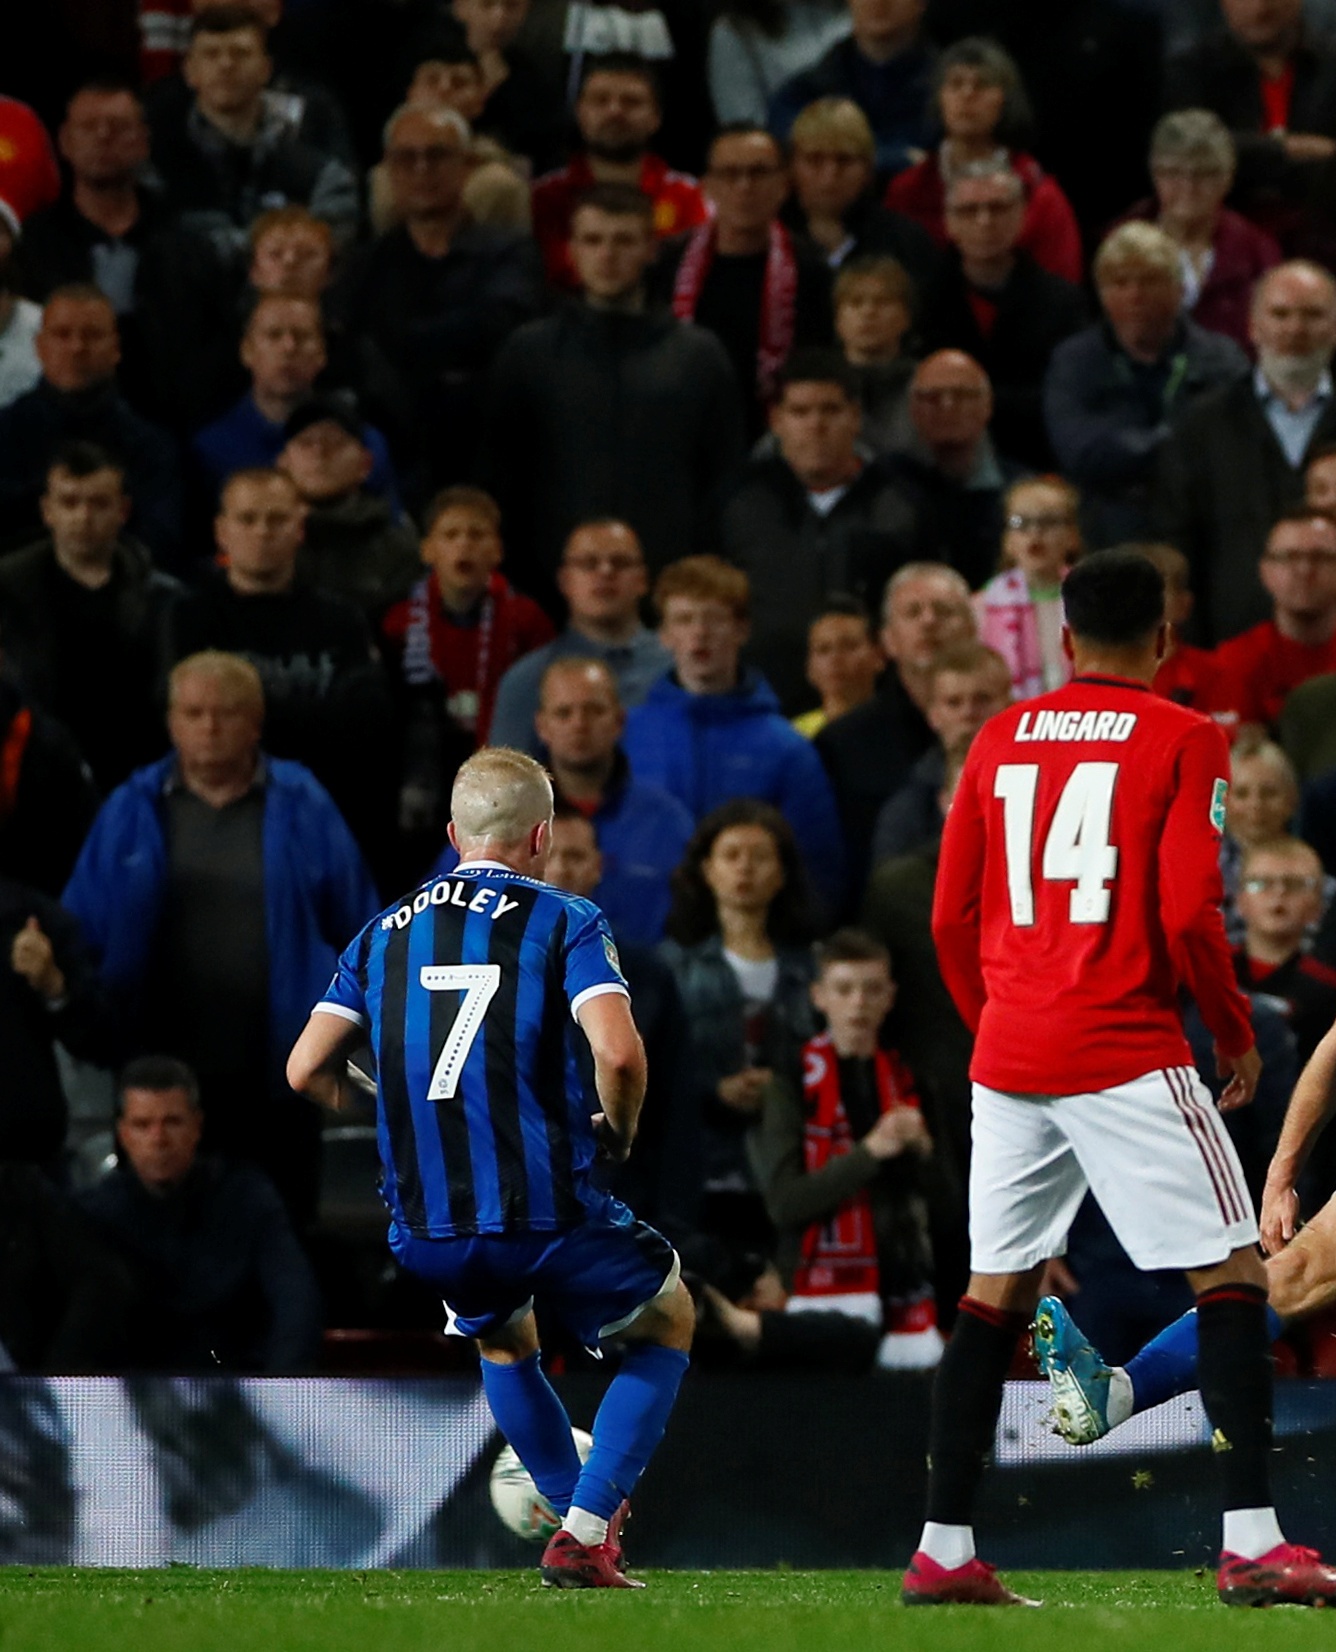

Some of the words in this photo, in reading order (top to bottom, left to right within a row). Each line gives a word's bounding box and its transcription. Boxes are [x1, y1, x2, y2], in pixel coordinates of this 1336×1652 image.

[1014, 710, 1137, 742] LINGARD
[994, 761, 1120, 926] 14
[393, 881, 519, 930] DOOLEY
[420, 964, 501, 1100] 7
